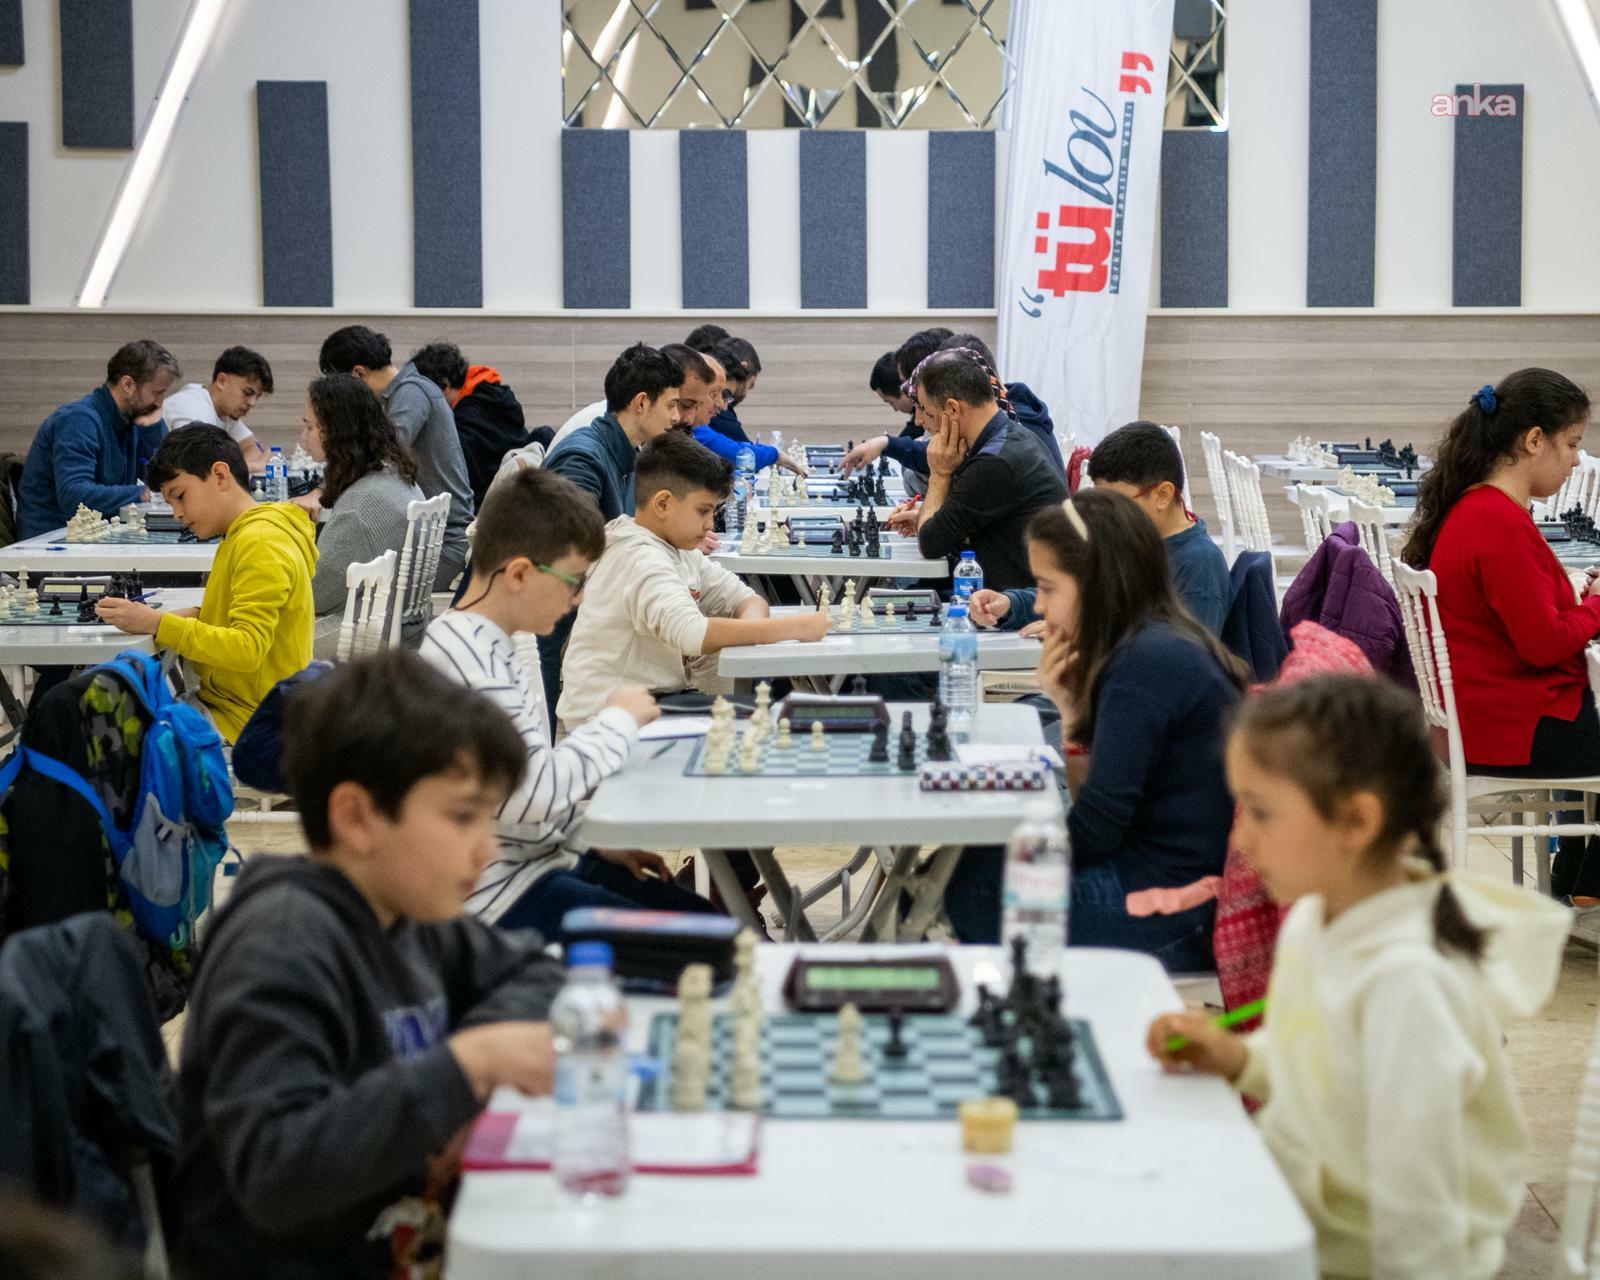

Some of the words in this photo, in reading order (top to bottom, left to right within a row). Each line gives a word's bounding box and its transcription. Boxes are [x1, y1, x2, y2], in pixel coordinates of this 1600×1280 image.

[1121, 104, 1133, 146] Vakfı
[1115, 158, 1128, 218] Tanıtım
[1110, 229, 1122, 291] Türkiye
